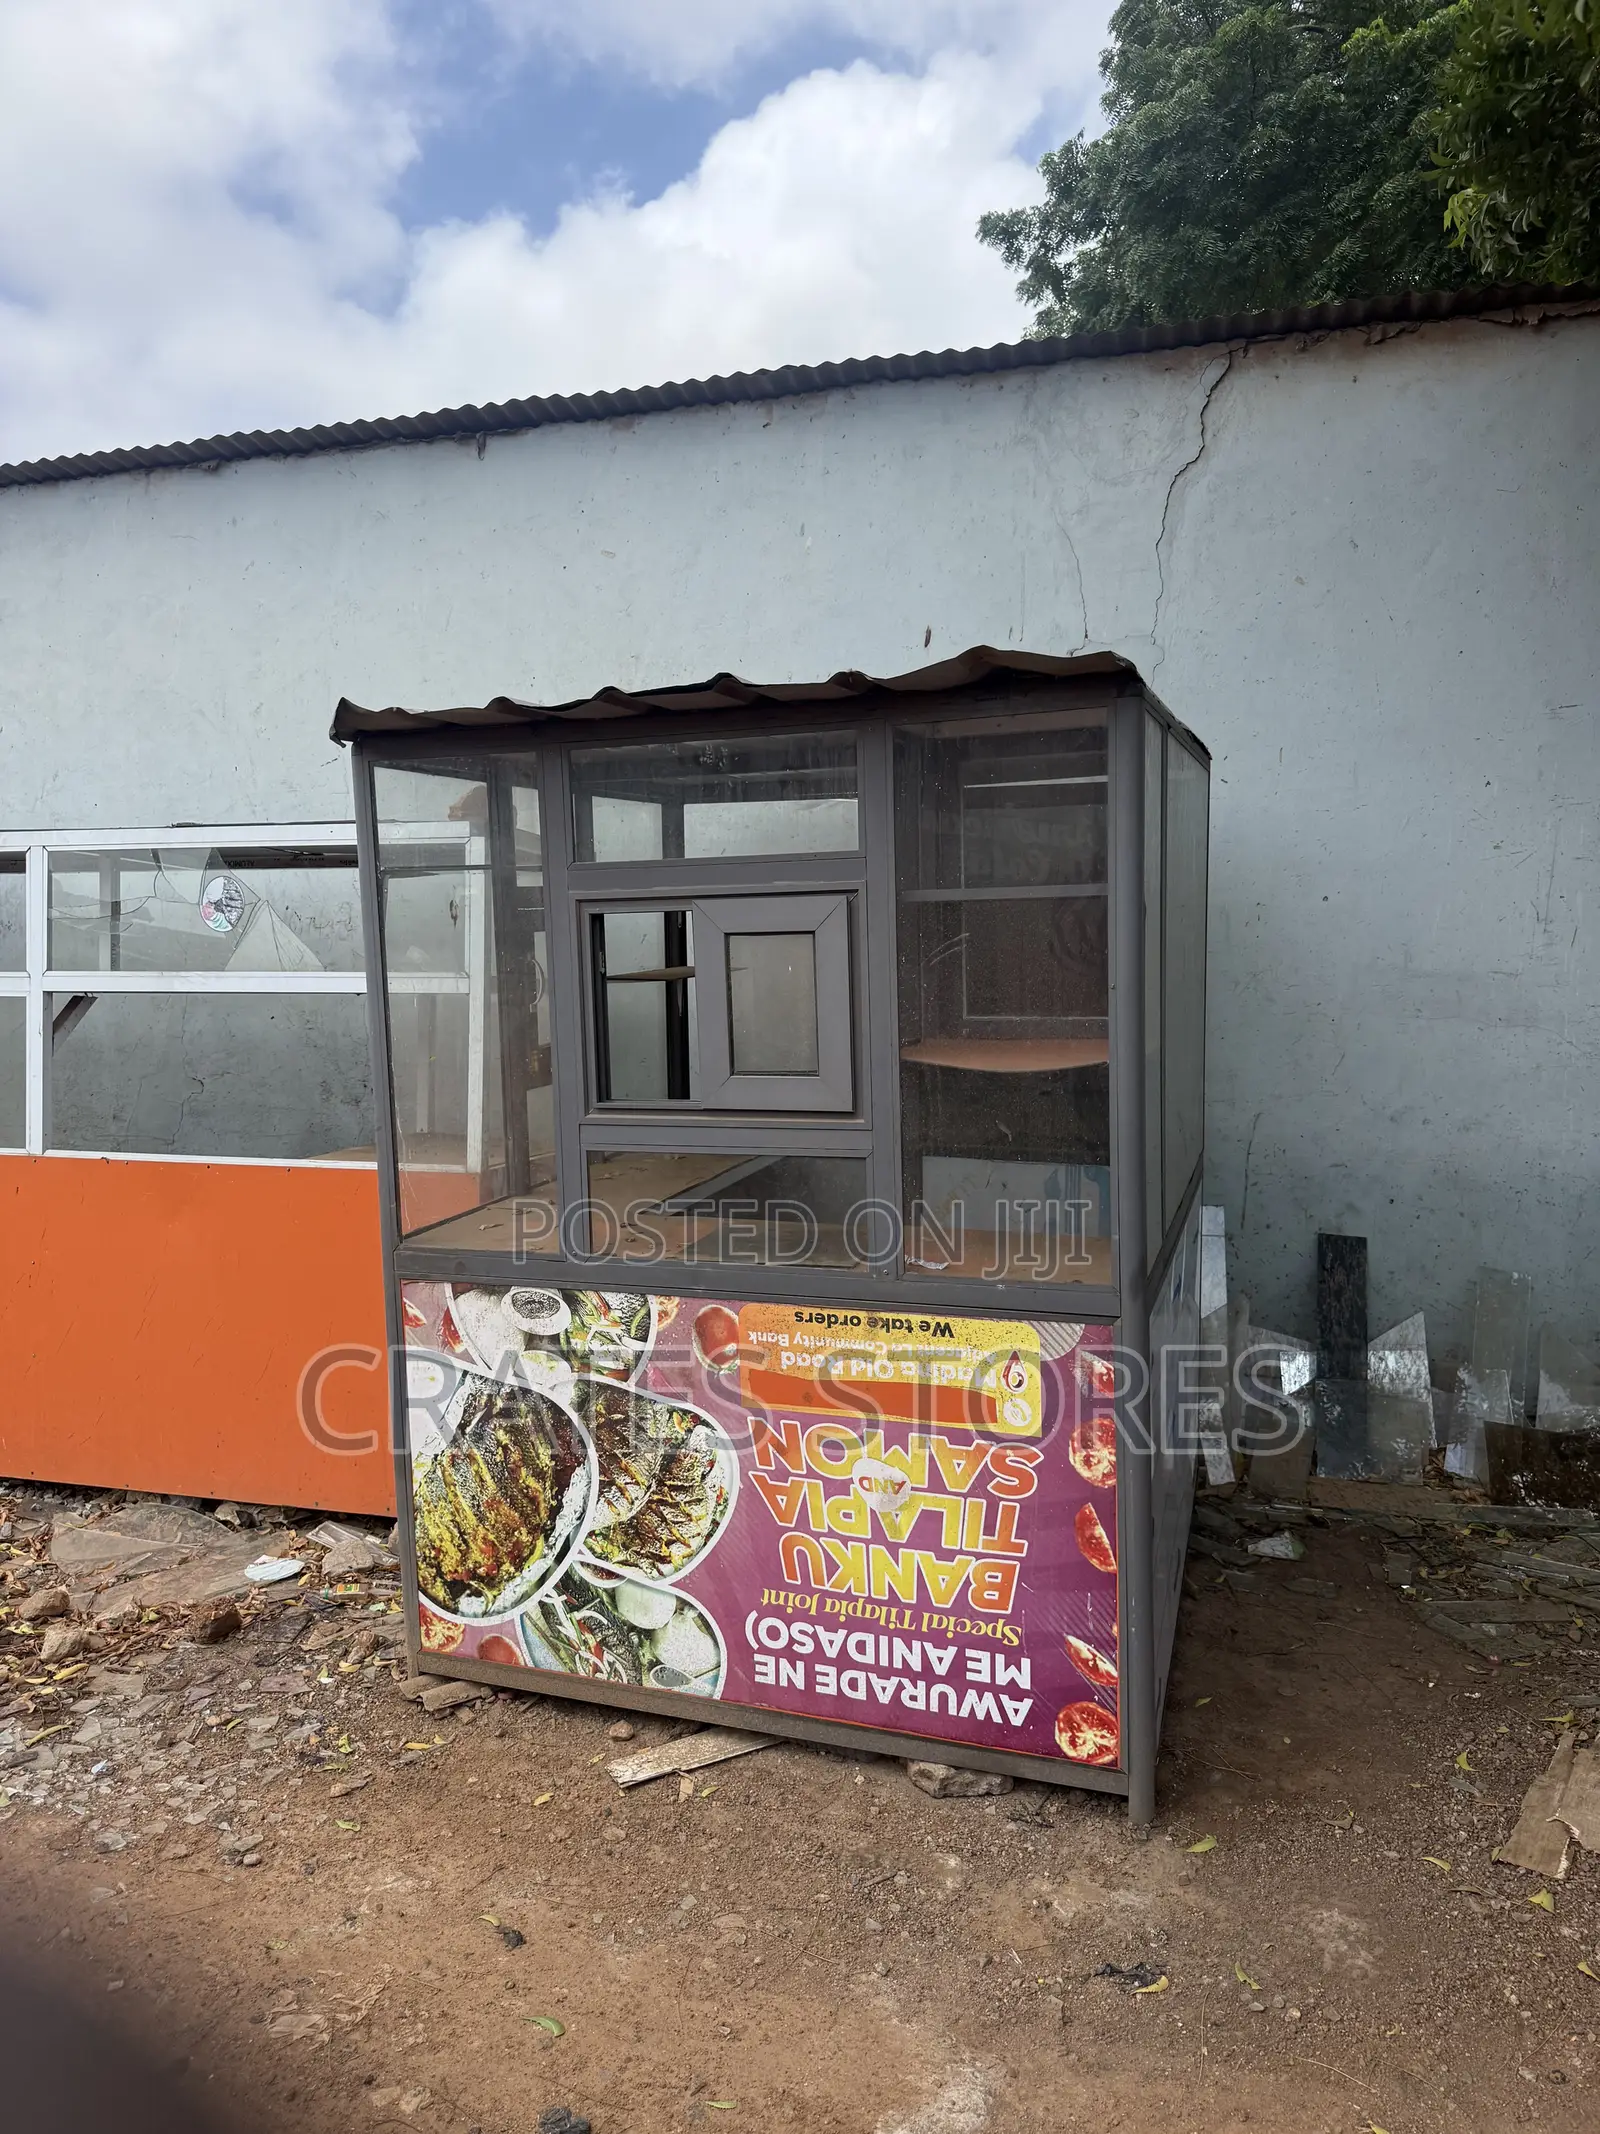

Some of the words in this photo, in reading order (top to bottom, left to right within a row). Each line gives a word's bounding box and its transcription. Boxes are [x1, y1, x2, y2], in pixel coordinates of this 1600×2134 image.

[794, 1311, 862, 1329] orders
[866, 1317, 914, 1334] take
[919, 1320, 955, 1338] We
[748, 1331, 790, 1347] Bank
[793, 1331, 889, 1354] Community
[780, 1351, 844, 1377] Road
[851, 1359, 895, 1379] Old
[900, 1359, 997, 1388] Madina
[747, 1416, 1044, 1499] SAMON
[858, 1475, 907, 1496] AND
[748, 1471, 1029, 1556] TILAPIA
[778, 1531, 1020, 1613] BANKU
[760, 1588, 820, 1615] Joint
[825, 1597, 916, 1632] Tilapia
[744, 1610, 959, 1672] ANIDASO)
[921, 1611, 1022, 1647] Special
[752, 1653, 806, 1690] NE
[966, 1648, 1032, 1690] ME
[814, 1664, 1034, 1727] AWURADE
